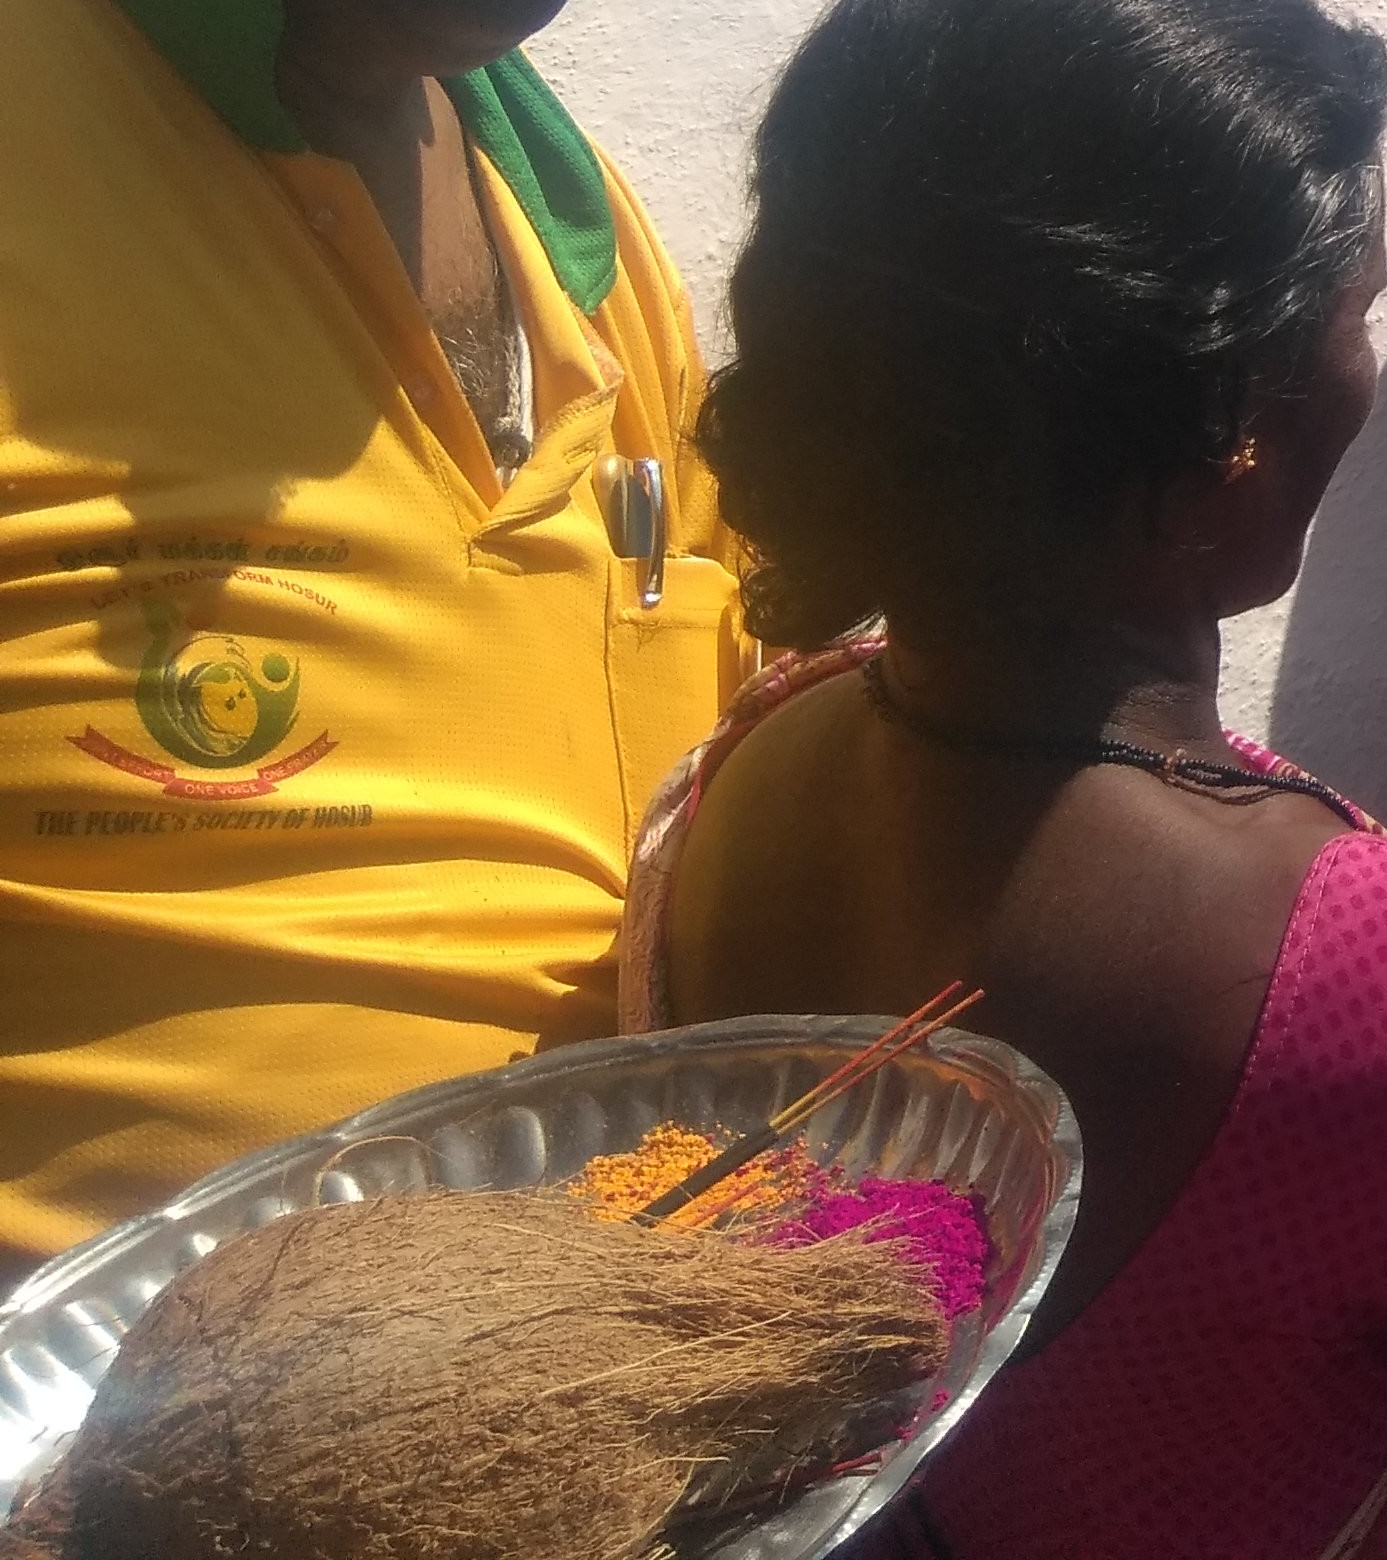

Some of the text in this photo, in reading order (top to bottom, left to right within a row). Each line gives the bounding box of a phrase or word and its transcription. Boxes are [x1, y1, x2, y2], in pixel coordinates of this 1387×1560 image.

[277, 578, 338, 615] HOSUR
[263, 765, 287, 781] ONE
[184, 783, 258, 795] ONE VOICE
[34, 804, 373, 836] THE PEOPLE'S SOCIETY OF HOSUR
